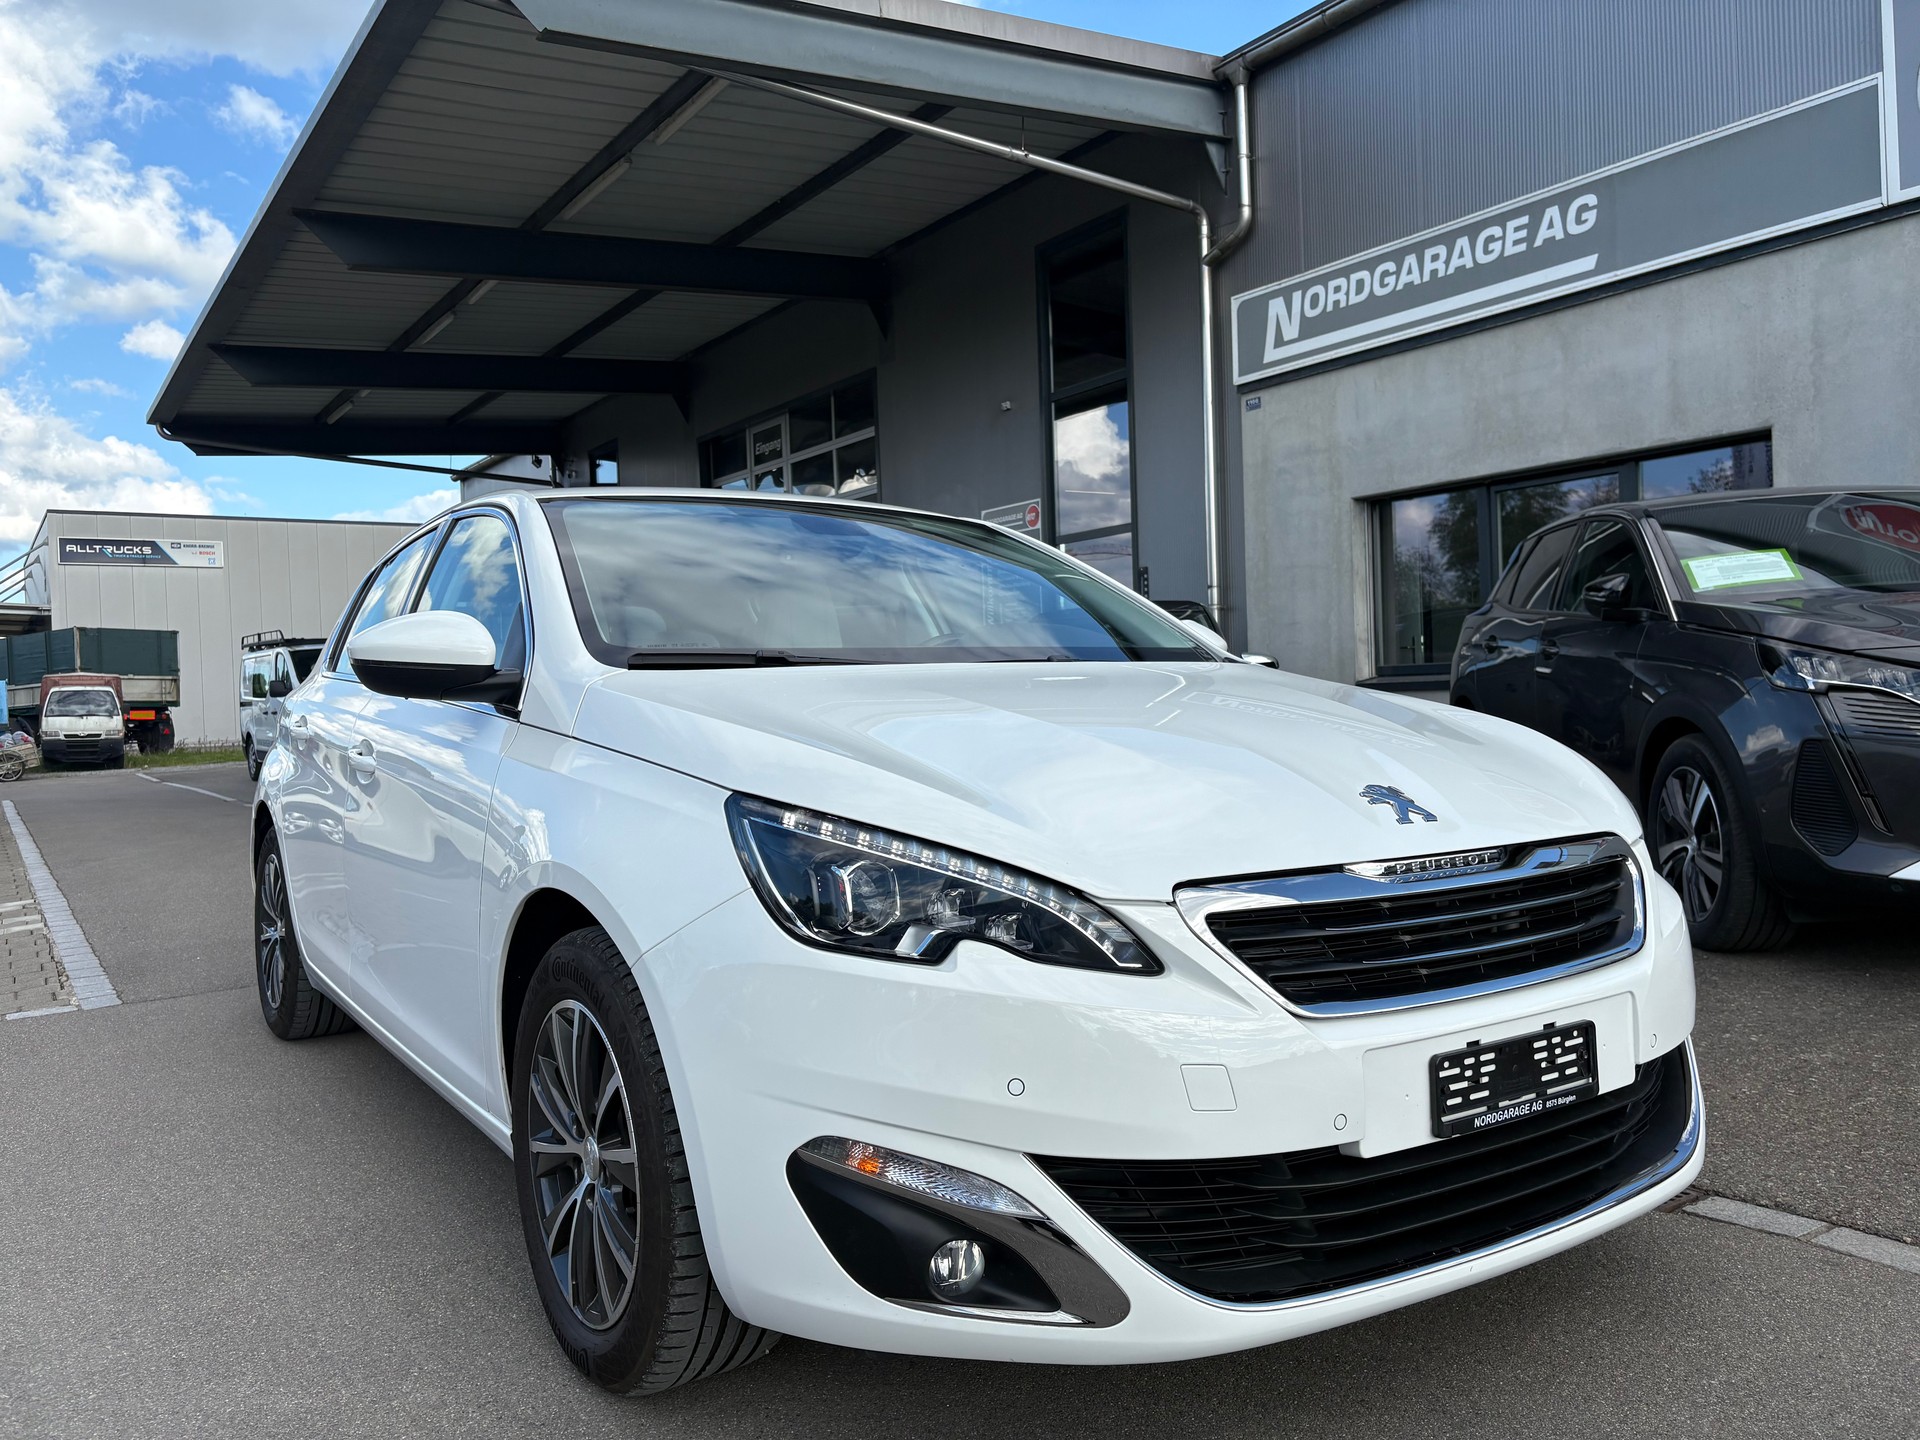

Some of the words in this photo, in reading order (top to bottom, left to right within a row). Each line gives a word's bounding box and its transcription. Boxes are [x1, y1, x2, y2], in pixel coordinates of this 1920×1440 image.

[1263, 214, 1529, 363] NORDGARAGE
[1533, 193, 1599, 248] AG
[755, 438, 781, 455] Eingang
[66, 544, 152, 555] ALLTRUCKS
[1395, 852, 1491, 875] PEUGEOT
[552, 956, 606, 1012] Continental
[1474, 1103, 1531, 1128] NORDGARAGE
[1531, 1100, 1543, 1115] AG
[1545, 1099, 1557, 1108] 8575
[1557, 1094, 1577, 1106] Bürglen
